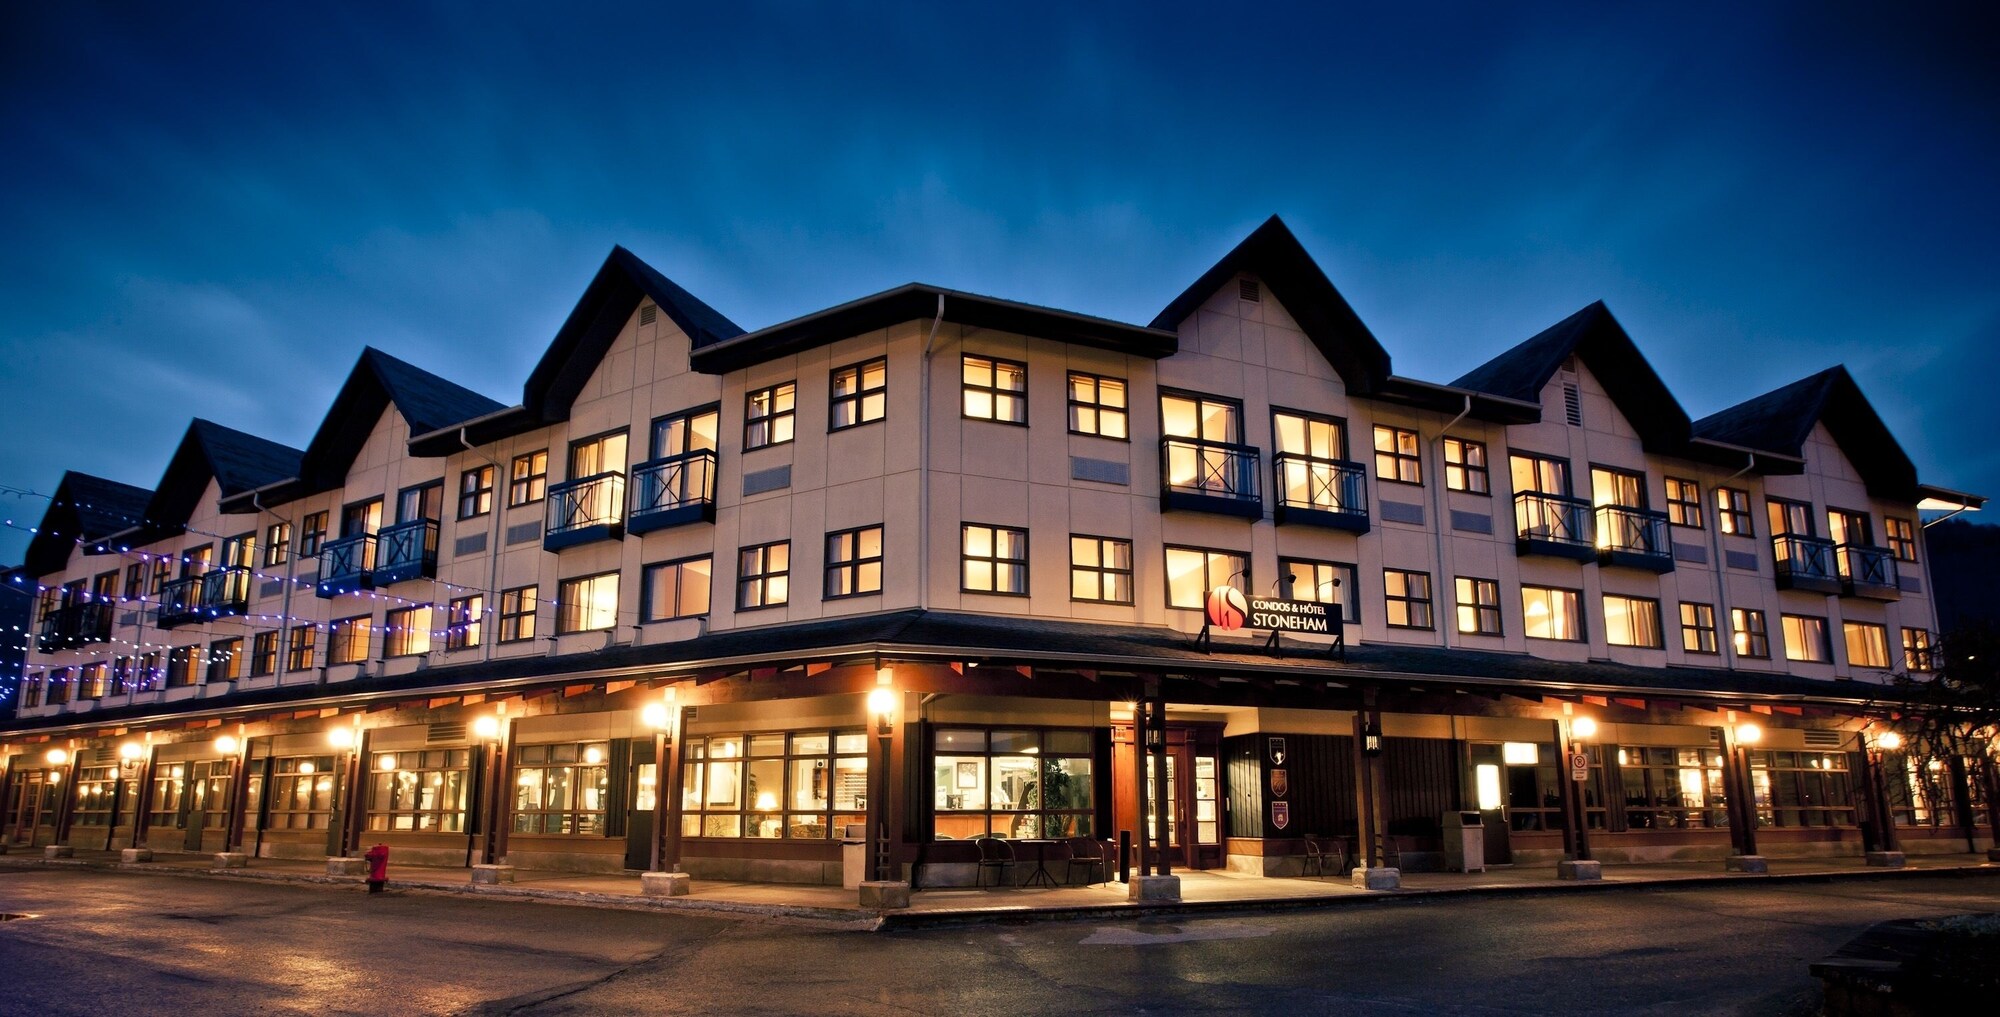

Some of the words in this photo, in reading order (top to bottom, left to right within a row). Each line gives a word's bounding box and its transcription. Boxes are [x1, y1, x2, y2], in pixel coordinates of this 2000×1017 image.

[1252, 600, 1291, 612] CONDOS
[1292, 604, 1298, 612] &
[1300, 603, 1326, 615] HÔTEL
[1253, 612, 1327, 632] STONEHAM
